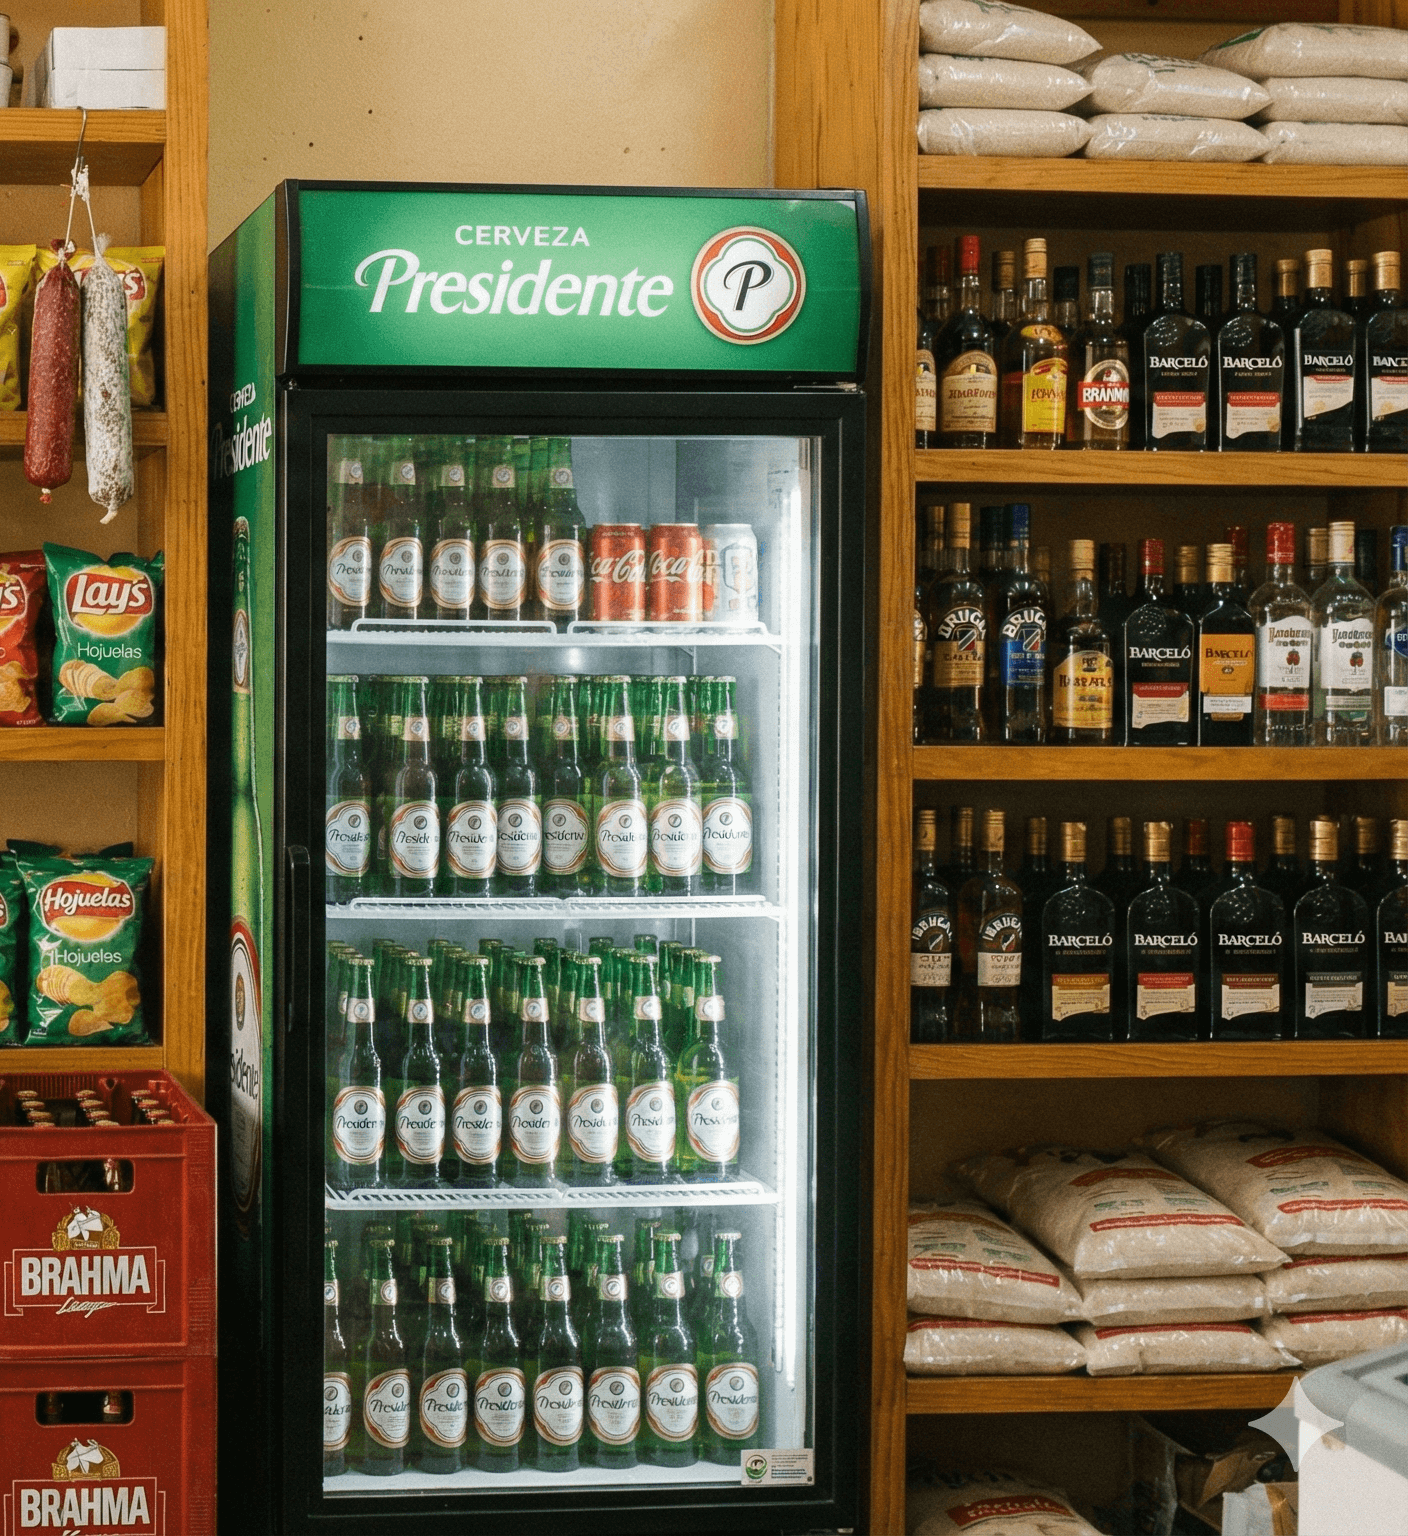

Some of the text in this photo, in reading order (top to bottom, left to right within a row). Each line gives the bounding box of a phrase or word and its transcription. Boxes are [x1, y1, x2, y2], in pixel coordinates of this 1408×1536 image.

[455, 225, 590, 247] CERVEZA
[354, 247, 674, 318] Presidente
[72, 574, 148, 616] Lay's
[77, 642, 142, 661] Hojuelas
[44, 887, 131, 915] Hojuelas
[1048, 932, 1113, 948] BARCELÓ
[1134, 931, 1198, 948] BARCELÓ
[1218, 931, 1282, 948] BARCELÓ
[1302, 930, 1366, 947] BARCELÓ
[21, 1254, 151, 1296] BRAHMA
[20, 1486, 151, 1527] BRAHMA
